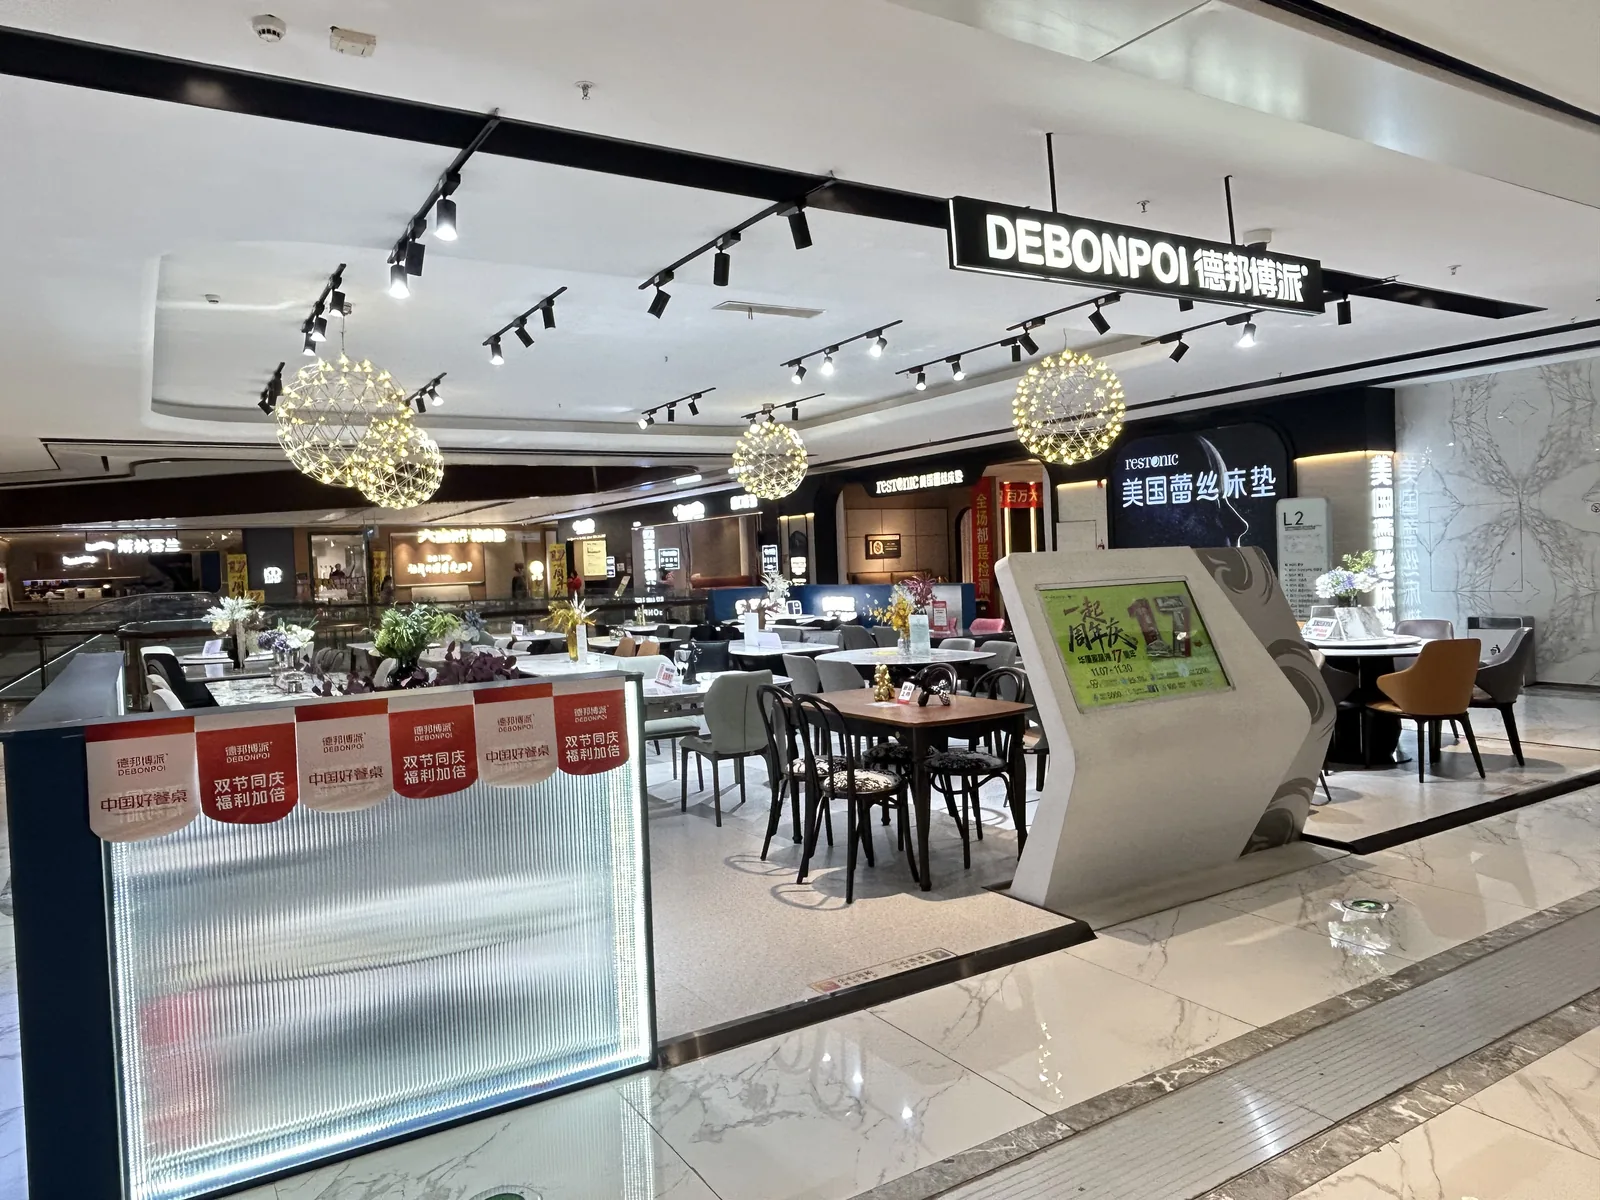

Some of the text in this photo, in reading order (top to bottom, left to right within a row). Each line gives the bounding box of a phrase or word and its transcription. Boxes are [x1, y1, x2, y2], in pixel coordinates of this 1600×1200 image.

[986, 214, 1304, 303] DEBONPOI 德邦博派
[1122, 464, 1277, 508] 美国蕾丝床垫
[1283, 511, 1304, 526] L2
[1063, 596, 1107, 624] 一起
[1068, 617, 1138, 653] 周年庆
[565, 731, 619, 748] 双节同庆
[117, 753, 166, 768] 德邦博派
[226, 752, 270, 763] DEBONPOI
[403, 750, 466, 769] 双节同庆
[486, 745, 550, 762] 中国好餐桌
[566, 745, 620, 763] 福利加倍
[117, 765, 167, 776] DEBONPOI
[309, 766, 384, 786] 中国好餐桌
[404, 765, 467, 785] 福利加倍
[214, 771, 285, 794] 双节同庆
[101, 790, 188, 812] 中国好餐桌
[215, 787, 286, 811] 福利加倍
